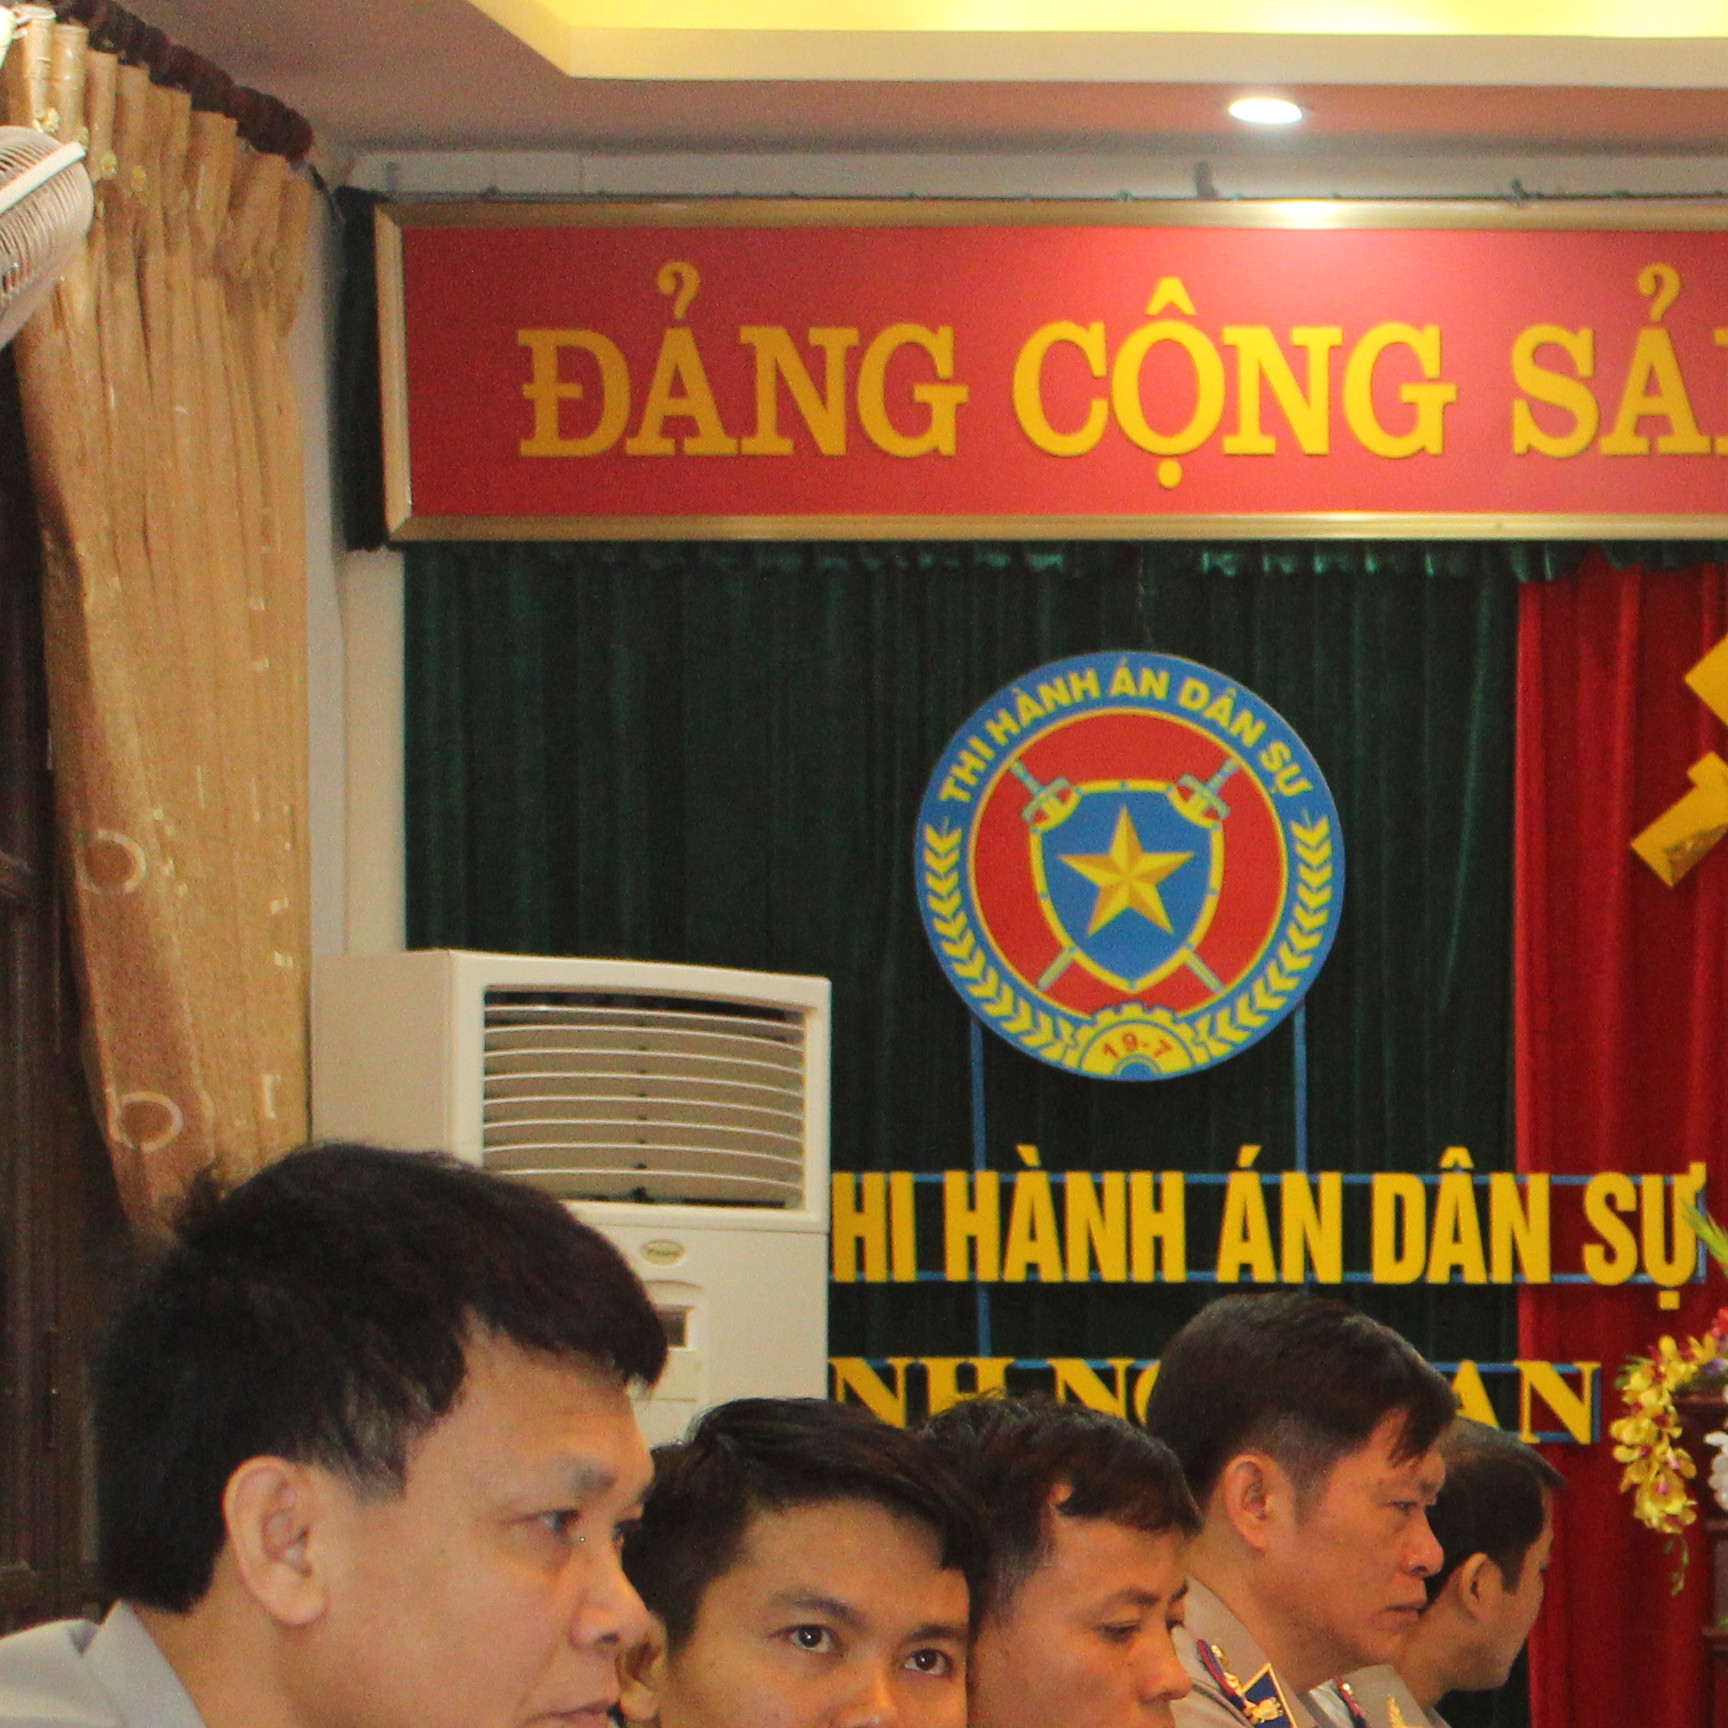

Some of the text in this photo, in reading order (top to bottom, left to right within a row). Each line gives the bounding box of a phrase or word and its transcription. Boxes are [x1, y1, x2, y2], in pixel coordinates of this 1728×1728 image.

[519, 262, 969, 458] ĐẢNG
[1012, 276, 1459, 488] CỘNG
[940, 656, 1315, 803] THI HÀNH ÁN DÂN SỰ
[831, 1144, 1707, 1311] HI HÀNH ÁN DÂN SỰ
